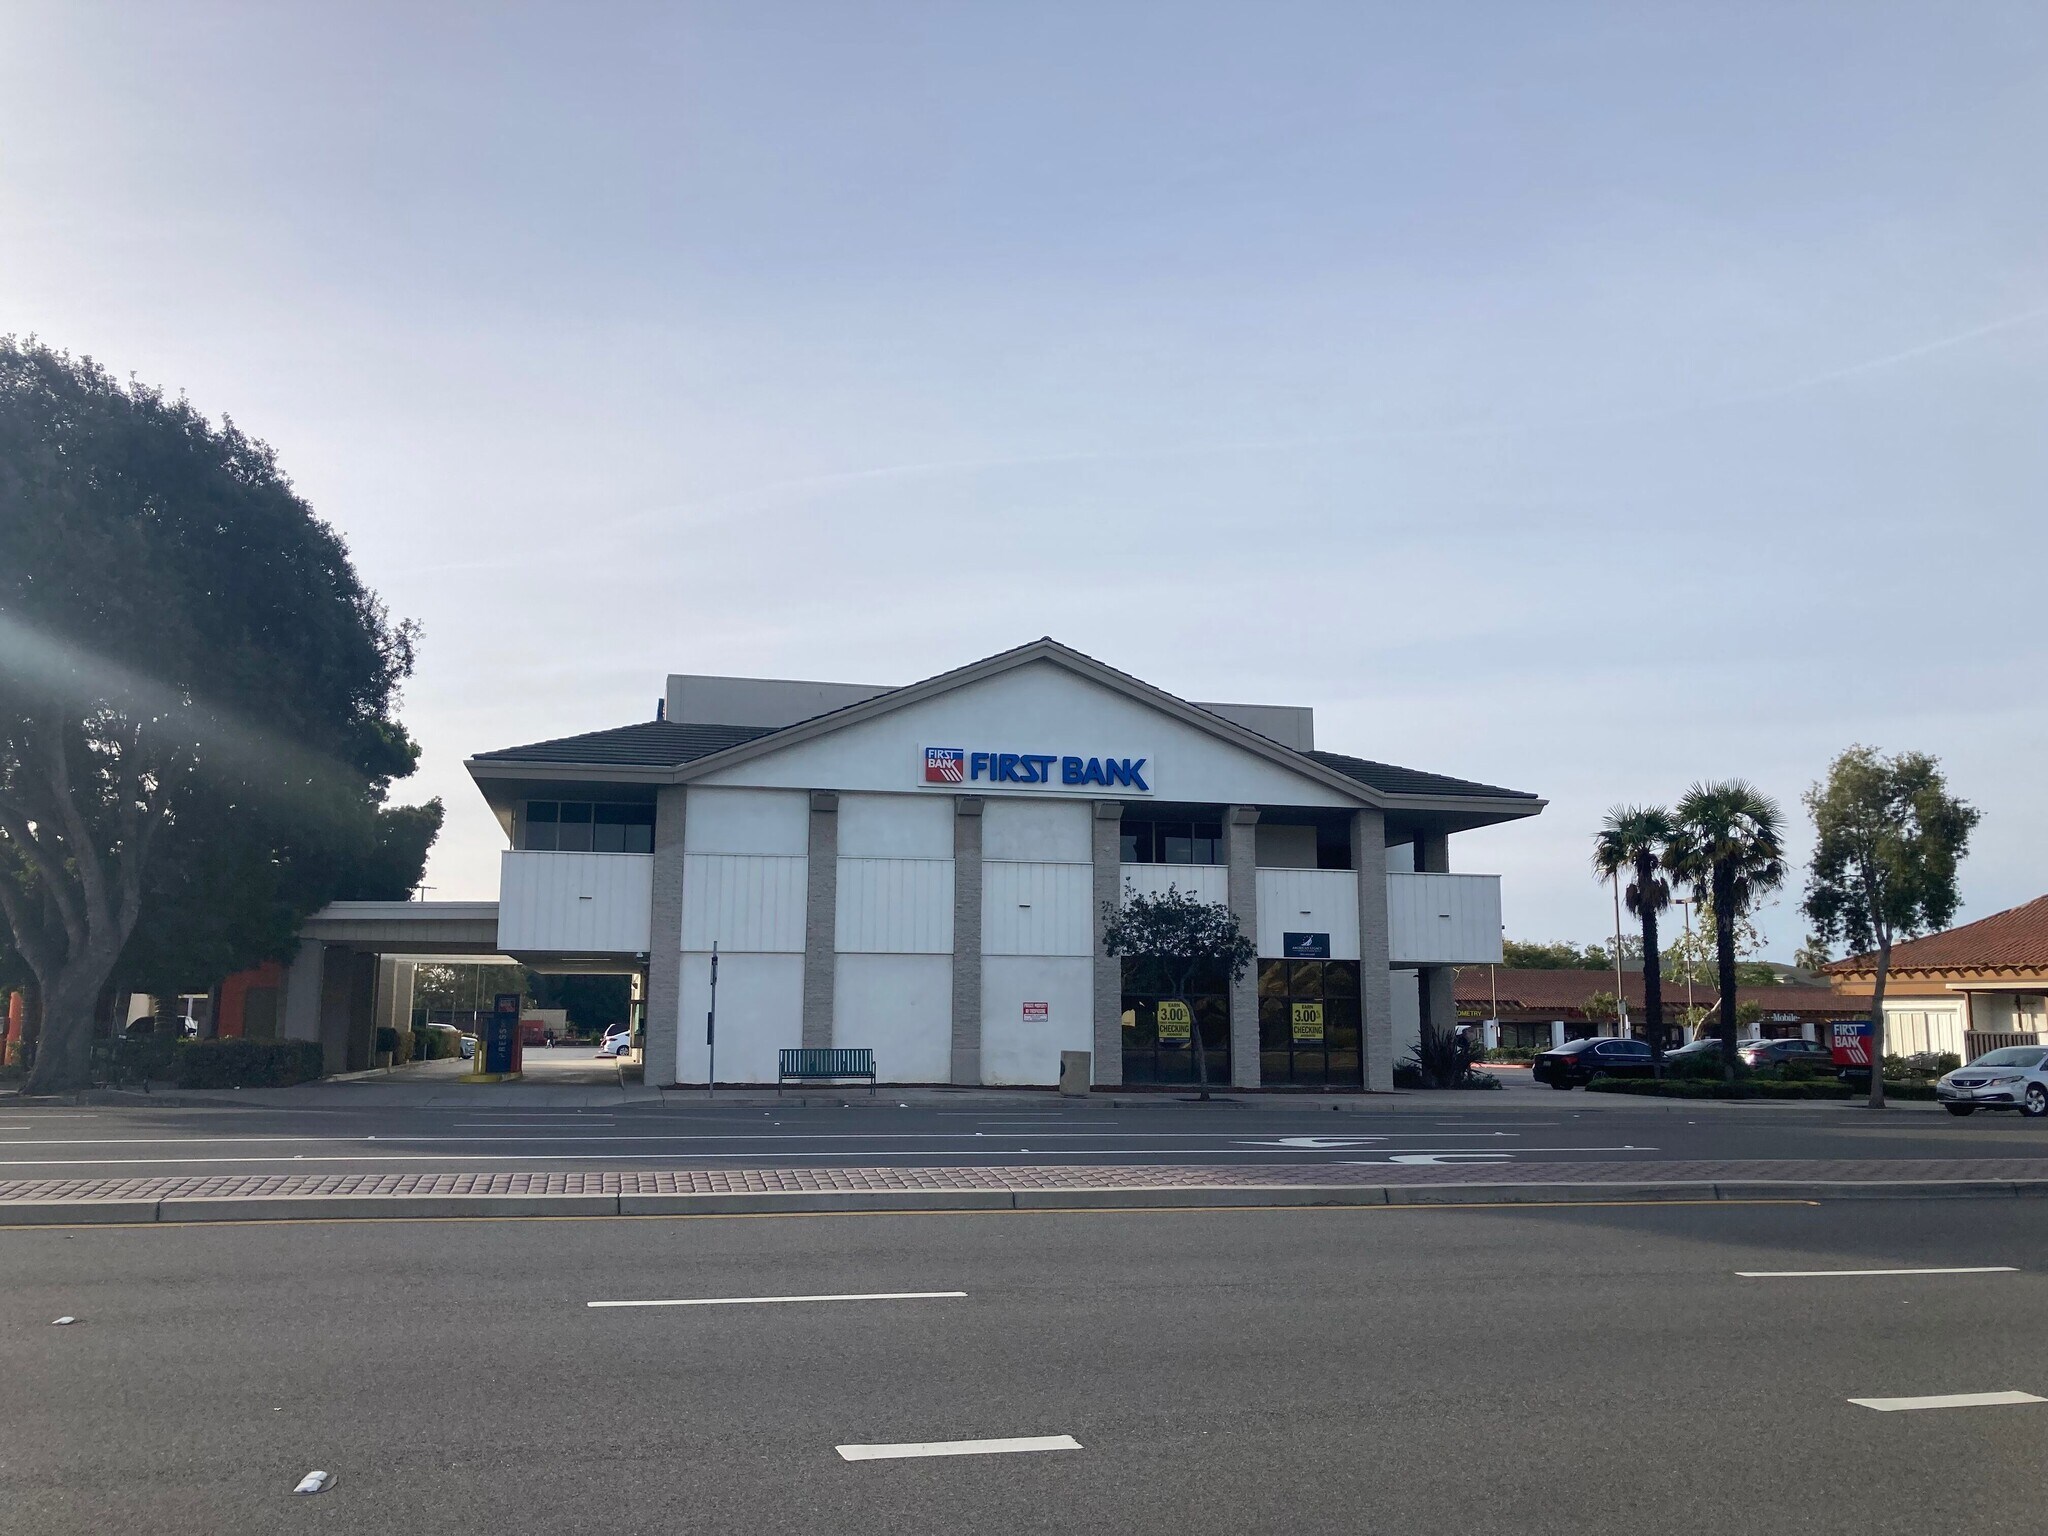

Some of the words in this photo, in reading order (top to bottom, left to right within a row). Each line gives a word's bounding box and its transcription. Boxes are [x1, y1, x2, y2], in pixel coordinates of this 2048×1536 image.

[928, 749, 960, 759] FIRST
[928, 759, 958, 770] BANK
[971, 752, 1057, 783] FIRST
[1062, 756, 1149, 791] BANK
[1294, 1026, 1322, 1034] CHECKING
[1834, 1024, 1863, 1035] FIRST
[1835, 1036, 1862, 1049] BANK
